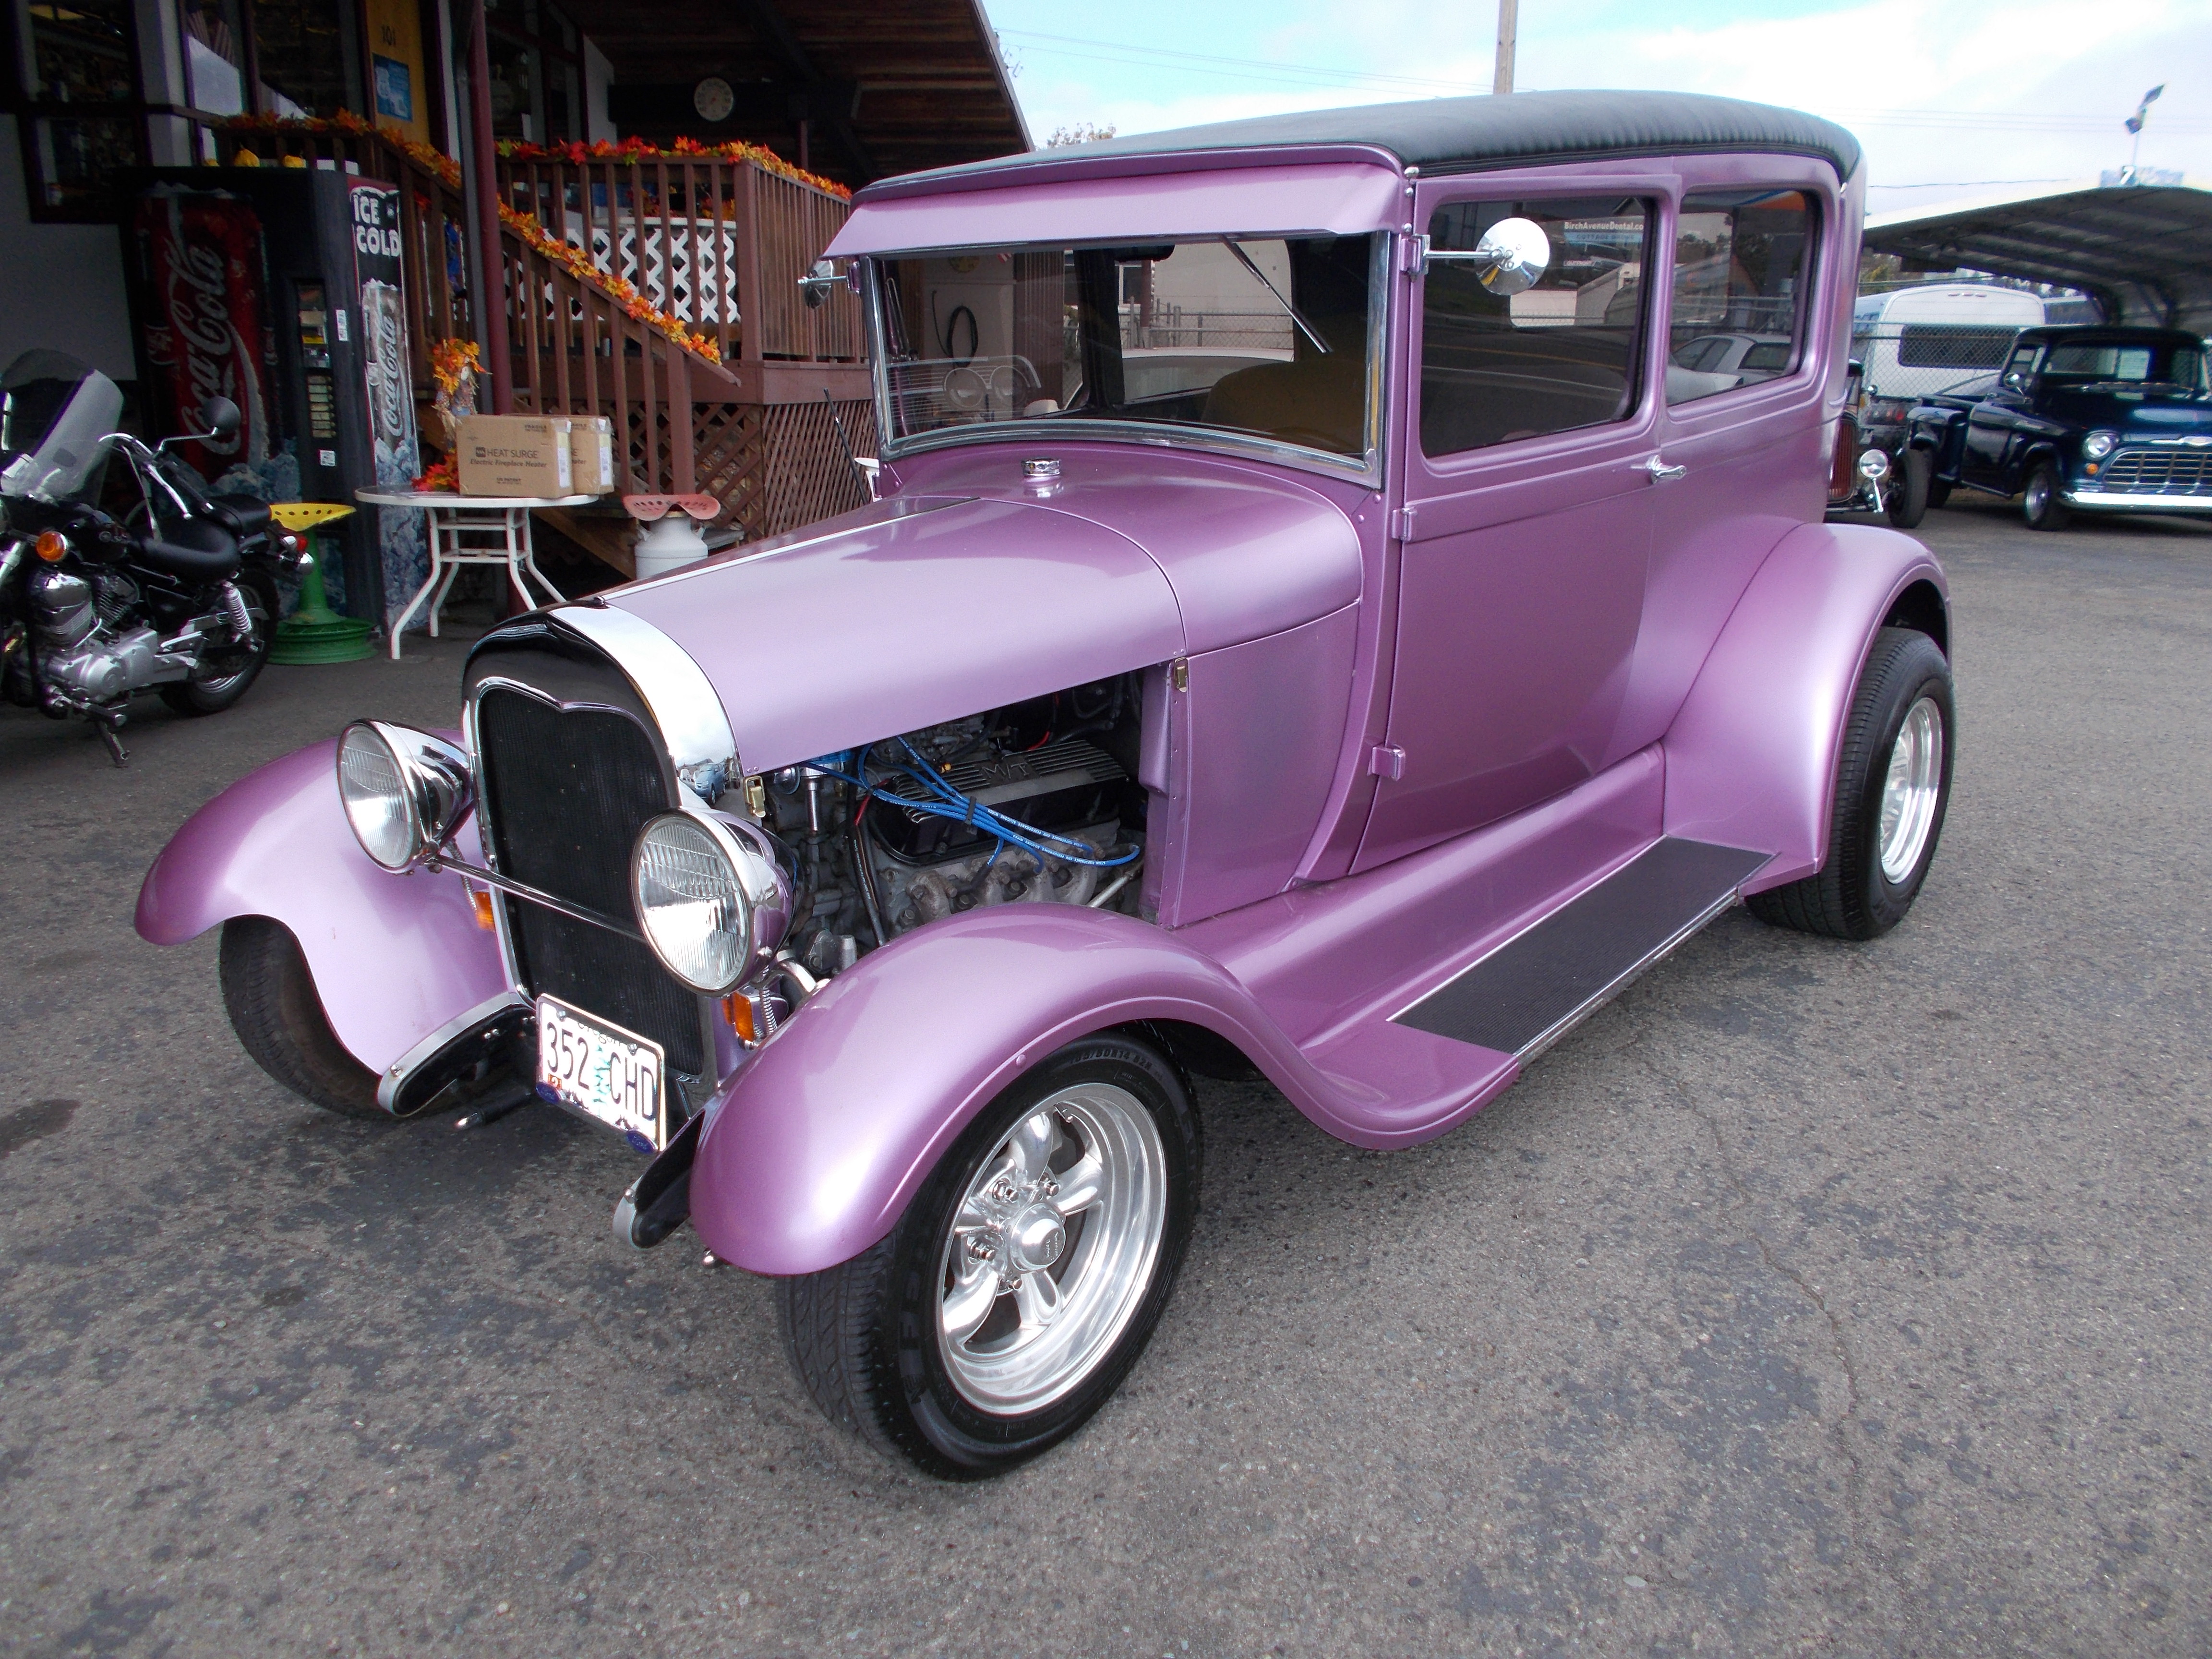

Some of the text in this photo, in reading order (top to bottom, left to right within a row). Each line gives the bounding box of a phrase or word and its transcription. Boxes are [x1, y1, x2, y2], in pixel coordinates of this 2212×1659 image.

[353, 194, 380, 225] ICE
[357, 225, 400, 257] COLD
[376, 315, 403, 436] Coca-Cola
[487, 449, 539, 458] HEAT SURGE
[1000, 815, 1016, 824] SILICONE
[547, 1022, 656, 1121] 352 CHD
